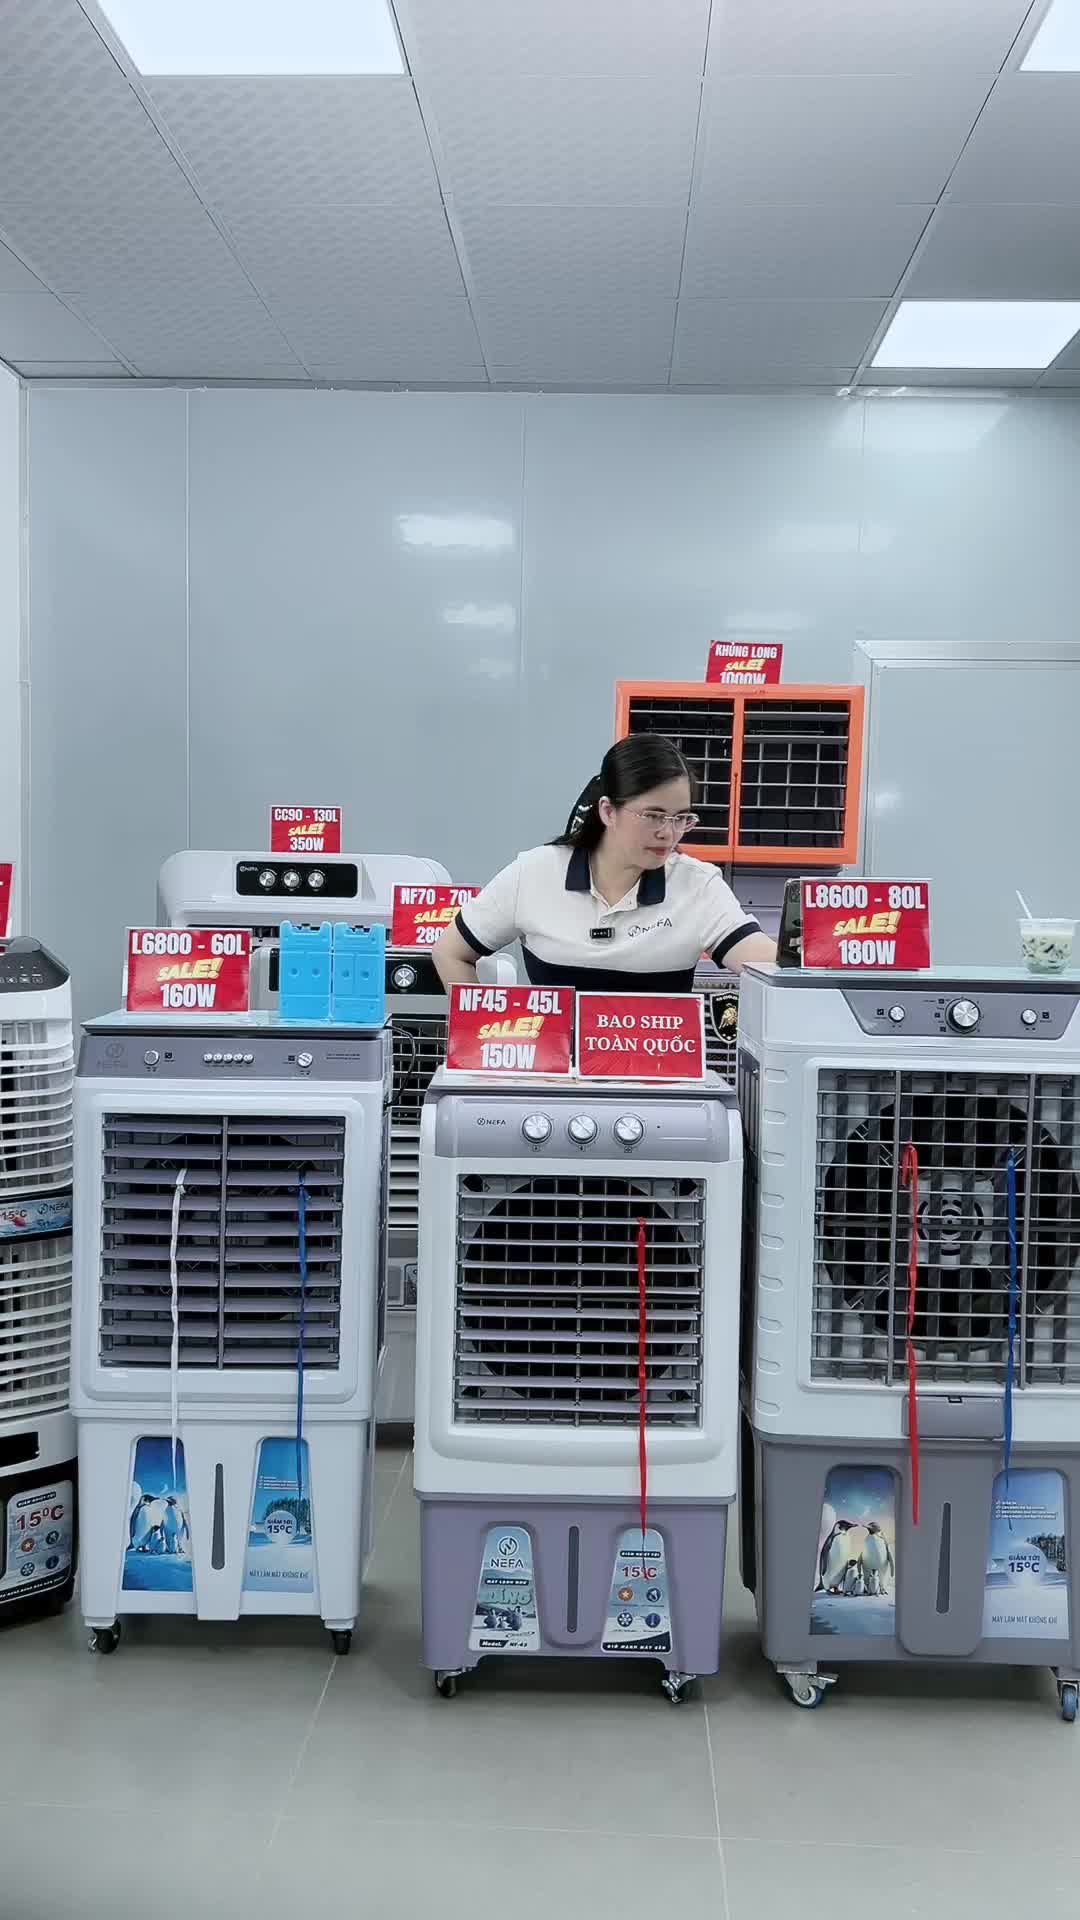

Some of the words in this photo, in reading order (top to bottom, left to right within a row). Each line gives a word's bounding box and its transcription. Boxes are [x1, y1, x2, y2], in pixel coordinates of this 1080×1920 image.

[715, 642, 749, 658] KHỦNG
[751, 647, 778, 659] LONG
[720, 672, 766, 684] 1000W
[274, 808, 303, 822] CC90
[313, 809, 339, 822] 130L
[290, 837, 325, 851] 350W
[400, 888, 436, 905] NF70
[805, 884, 869, 909] L8600
[888, 885, 926, 910] 80L
[832, 911, 902, 937] SALE!
[131, 932, 192, 955] L6800
[211, 933, 247, 955] 60L
[416, 926, 444, 944] 280
[838, 939, 897, 965] 180W
[156, 957, 224, 982] SALE!
[160, 983, 217, 1008] 160W
[459, 988, 507, 1013] NF45
[526, 990, 563, 1015] 45L
[477, 1015, 545, 1041] SALE!
[596, 1014, 636, 1029] BAO
[640, 1015, 684, 1030] SHIP
[585, 1034, 638, 1051] TOÀN
[643, 1034, 696, 1056] QUỐC
[480, 1043, 537, 1070] 150W
[486, 1118, 507, 1126] NEFA
[16, 1504, 64, 1531] 15°C
[267, 1525, 293, 1535] 15°C
[490, 1558, 524, 1568] NEFA
[1008, 1561, 1040, 1573] 15°C
